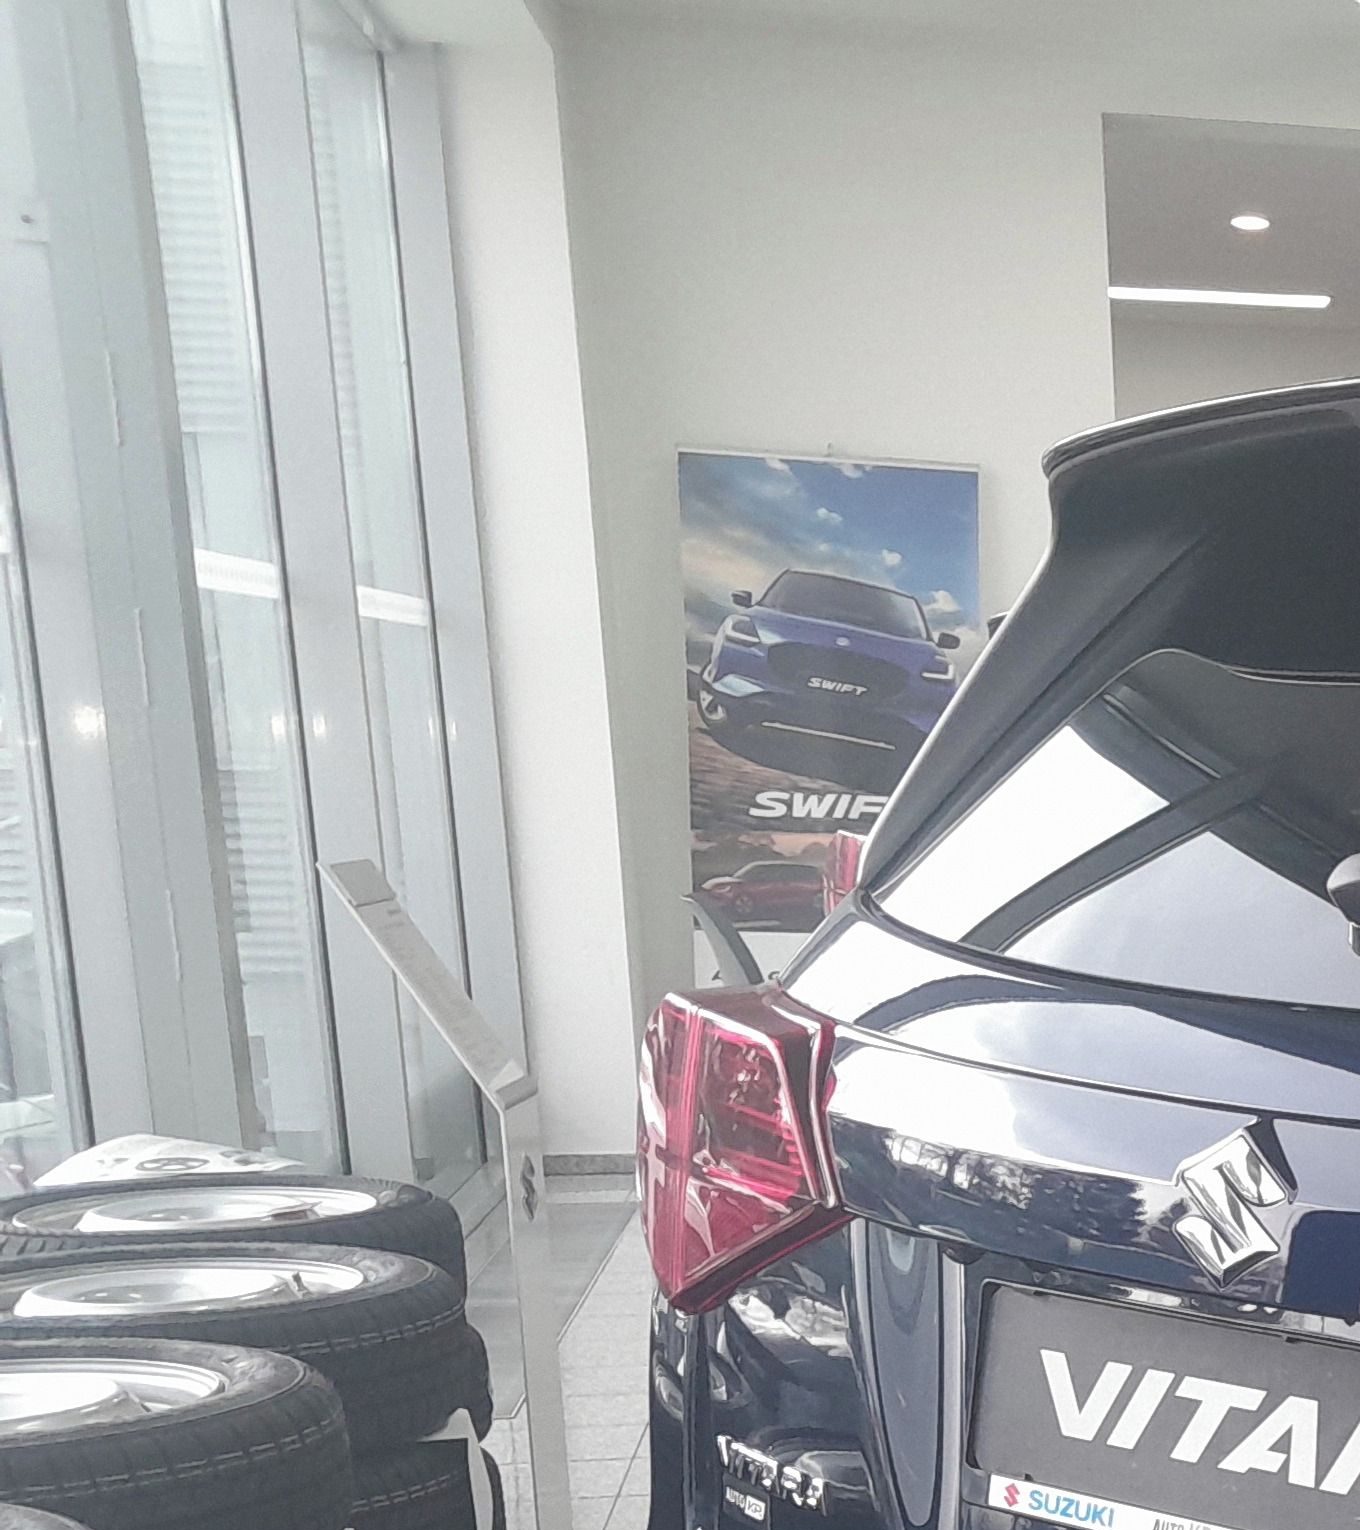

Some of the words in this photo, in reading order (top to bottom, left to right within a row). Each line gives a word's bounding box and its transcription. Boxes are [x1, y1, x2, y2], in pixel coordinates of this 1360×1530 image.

[805, 675, 868, 697] SWIFT
[748, 790, 888, 820] SWIF
[1027, 1488, 1115, 1530] SUZUKI
